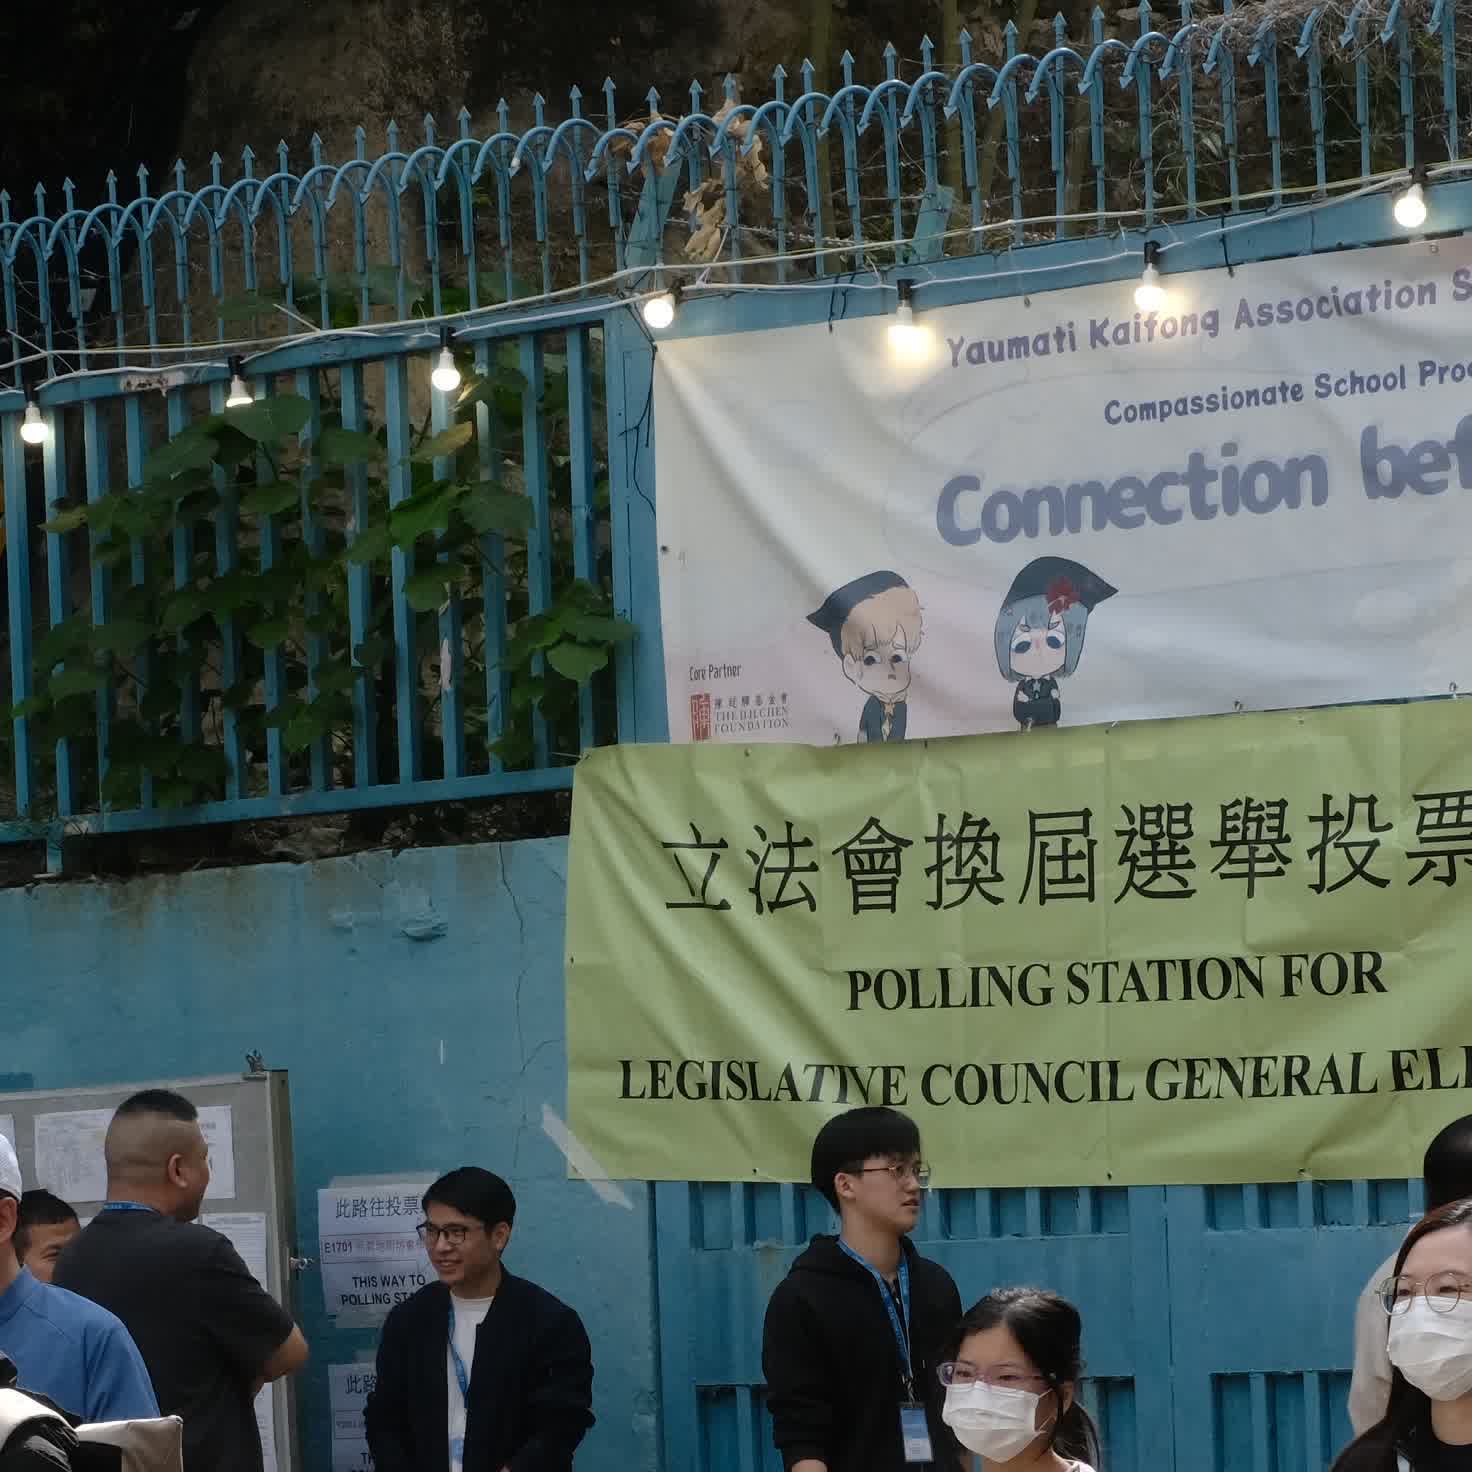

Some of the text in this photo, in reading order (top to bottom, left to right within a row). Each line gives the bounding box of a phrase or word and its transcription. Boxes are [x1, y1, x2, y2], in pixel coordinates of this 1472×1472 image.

[947, 320, 1077, 368] Yaumati
[1088, 304, 1220, 350] Kaifong
[1233, 280, 1438, 332] Association
[1104, 381, 1305, 427] Compassionate
[1314, 364, 1407, 400] School
[936, 442, 1329, 549] Connection
[689, 663, 742, 681] Core Partner
[844, 950, 1389, 1011] POLLING STATION FOR
[618, 1058, 908, 1107] LEGISLATIVE
[921, 1059, 1136, 1107] COUNCIL
[1145, 1052, 1379, 1102] GENERAL
[335, 1194, 424, 1219] 此路往投票
[340, 1292, 391, 1306] POLLING
[352, 1274, 426, 1290] THIS WAY TO
